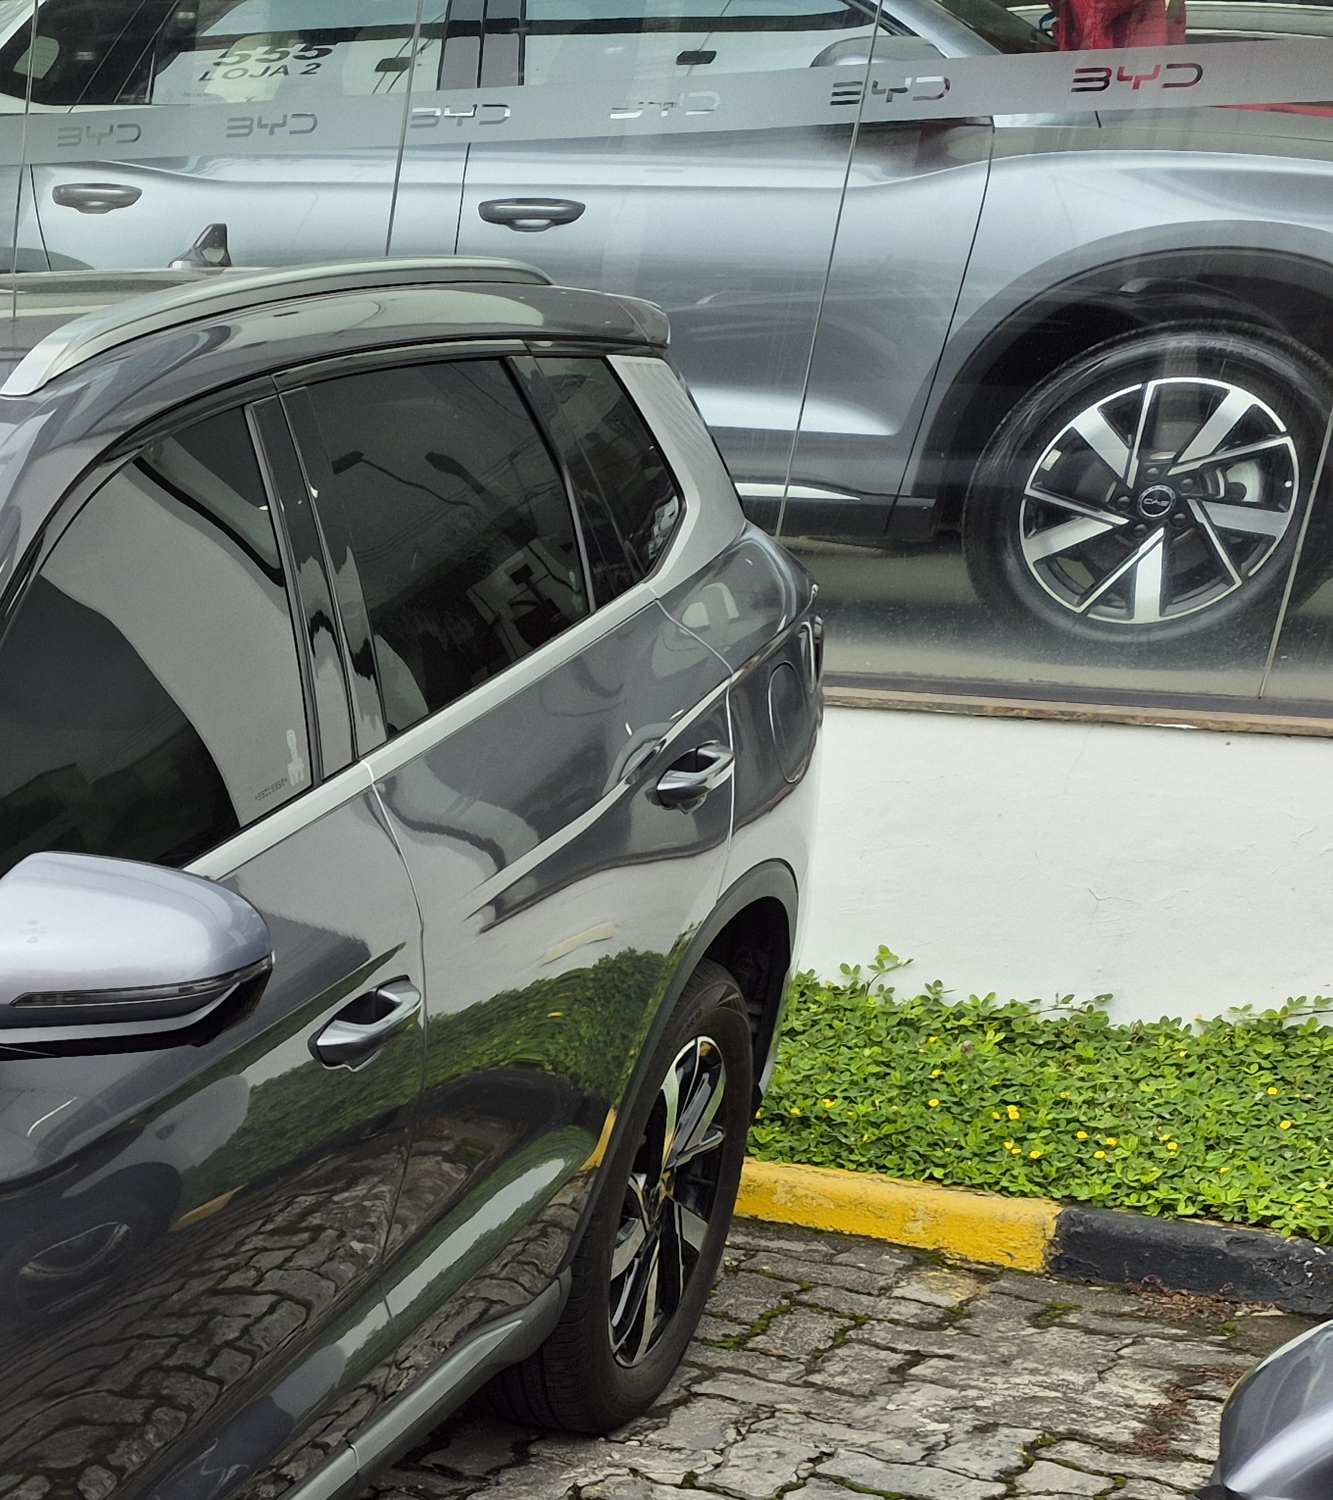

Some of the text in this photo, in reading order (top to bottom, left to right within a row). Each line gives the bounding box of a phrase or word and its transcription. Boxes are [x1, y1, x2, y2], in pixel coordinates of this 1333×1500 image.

[198, 62, 322, 82] LOJA 2
[1071, 63, 1204, 93] BYD
[830, 75, 951, 106] BYD
[225, 114, 318, 139] BYD
[410, 102, 511, 129] BYD
[56, 124, 142, 148] BYD
